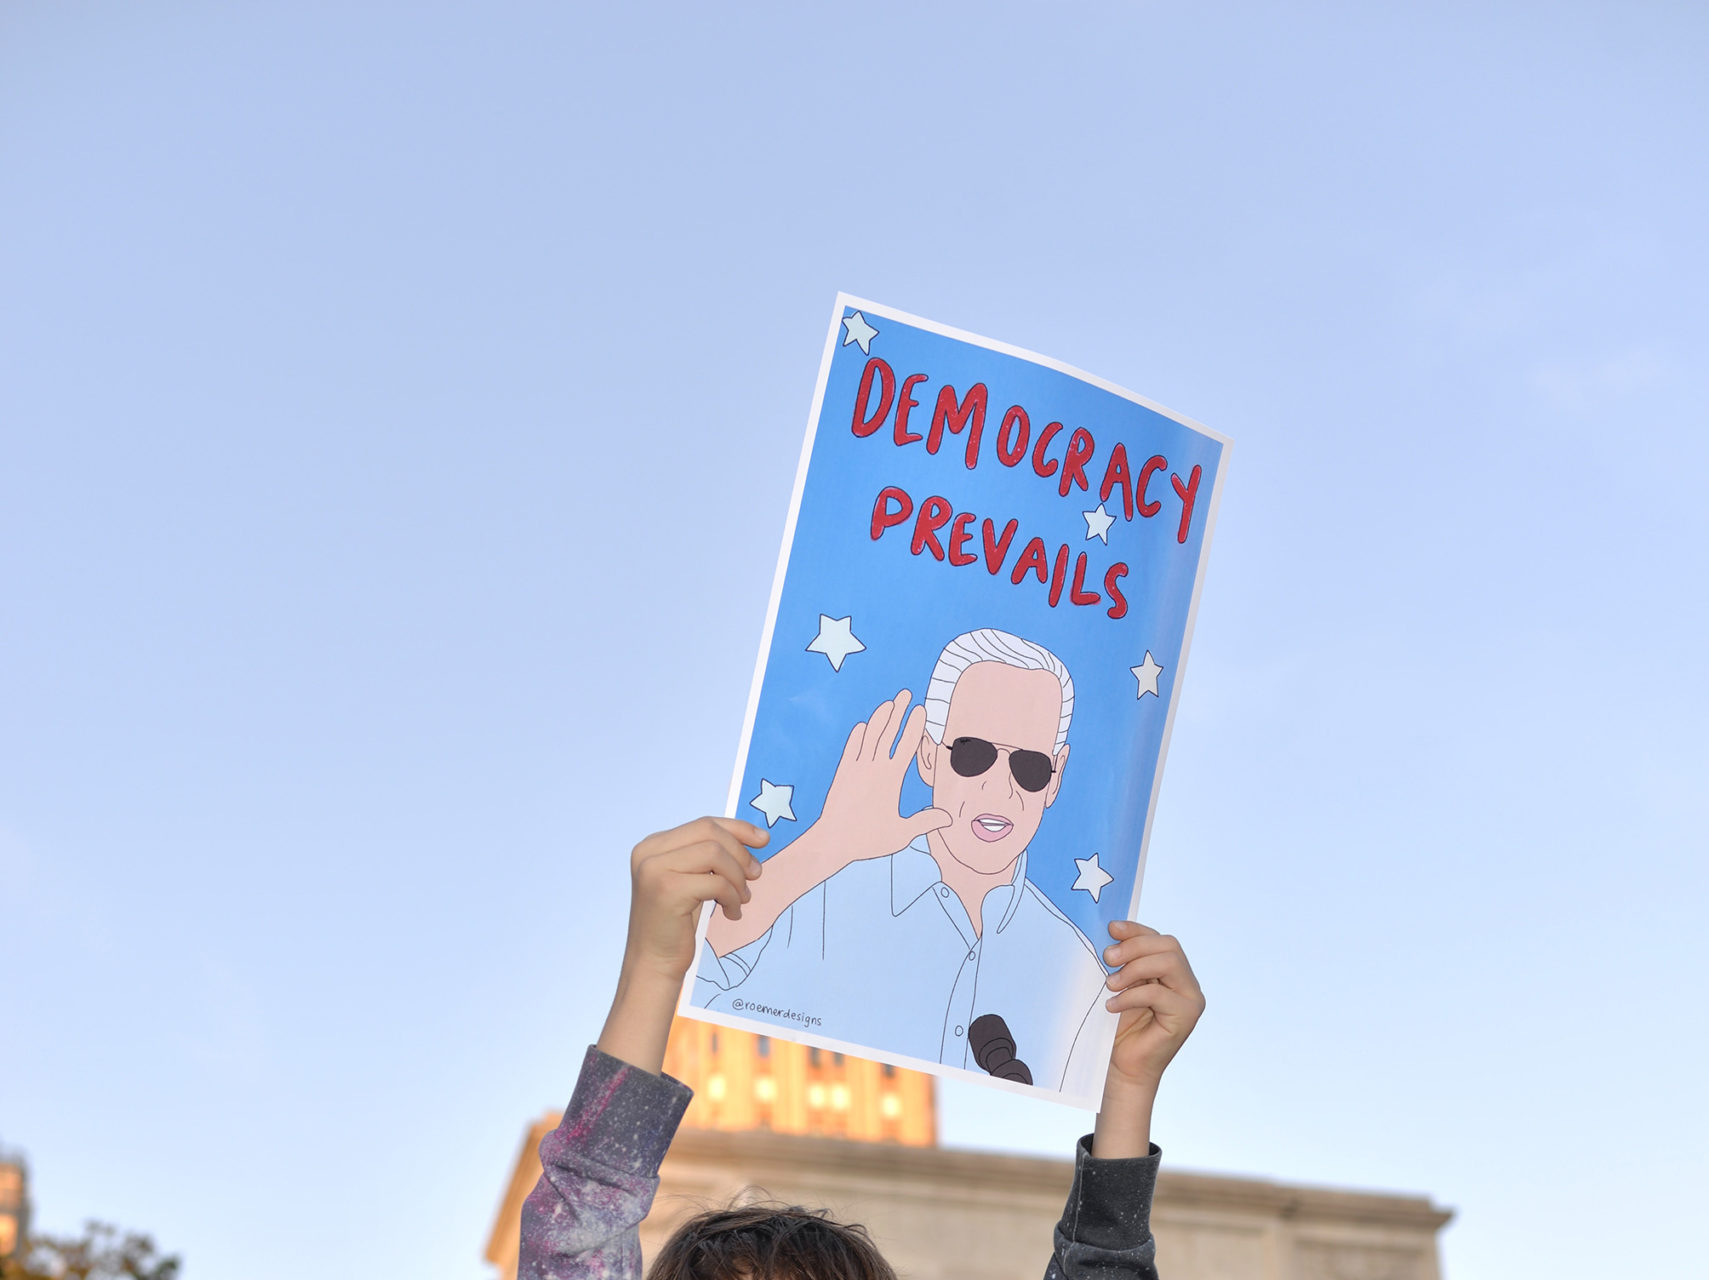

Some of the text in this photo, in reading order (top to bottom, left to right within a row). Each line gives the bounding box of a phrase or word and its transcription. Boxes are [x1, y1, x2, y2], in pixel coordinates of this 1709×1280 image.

[851, 357, 1202, 543] DEMOCRACY
[870, 486, 1129, 619] PREVAILS
[732, 998, 822, 1028] @roemerdesigns
